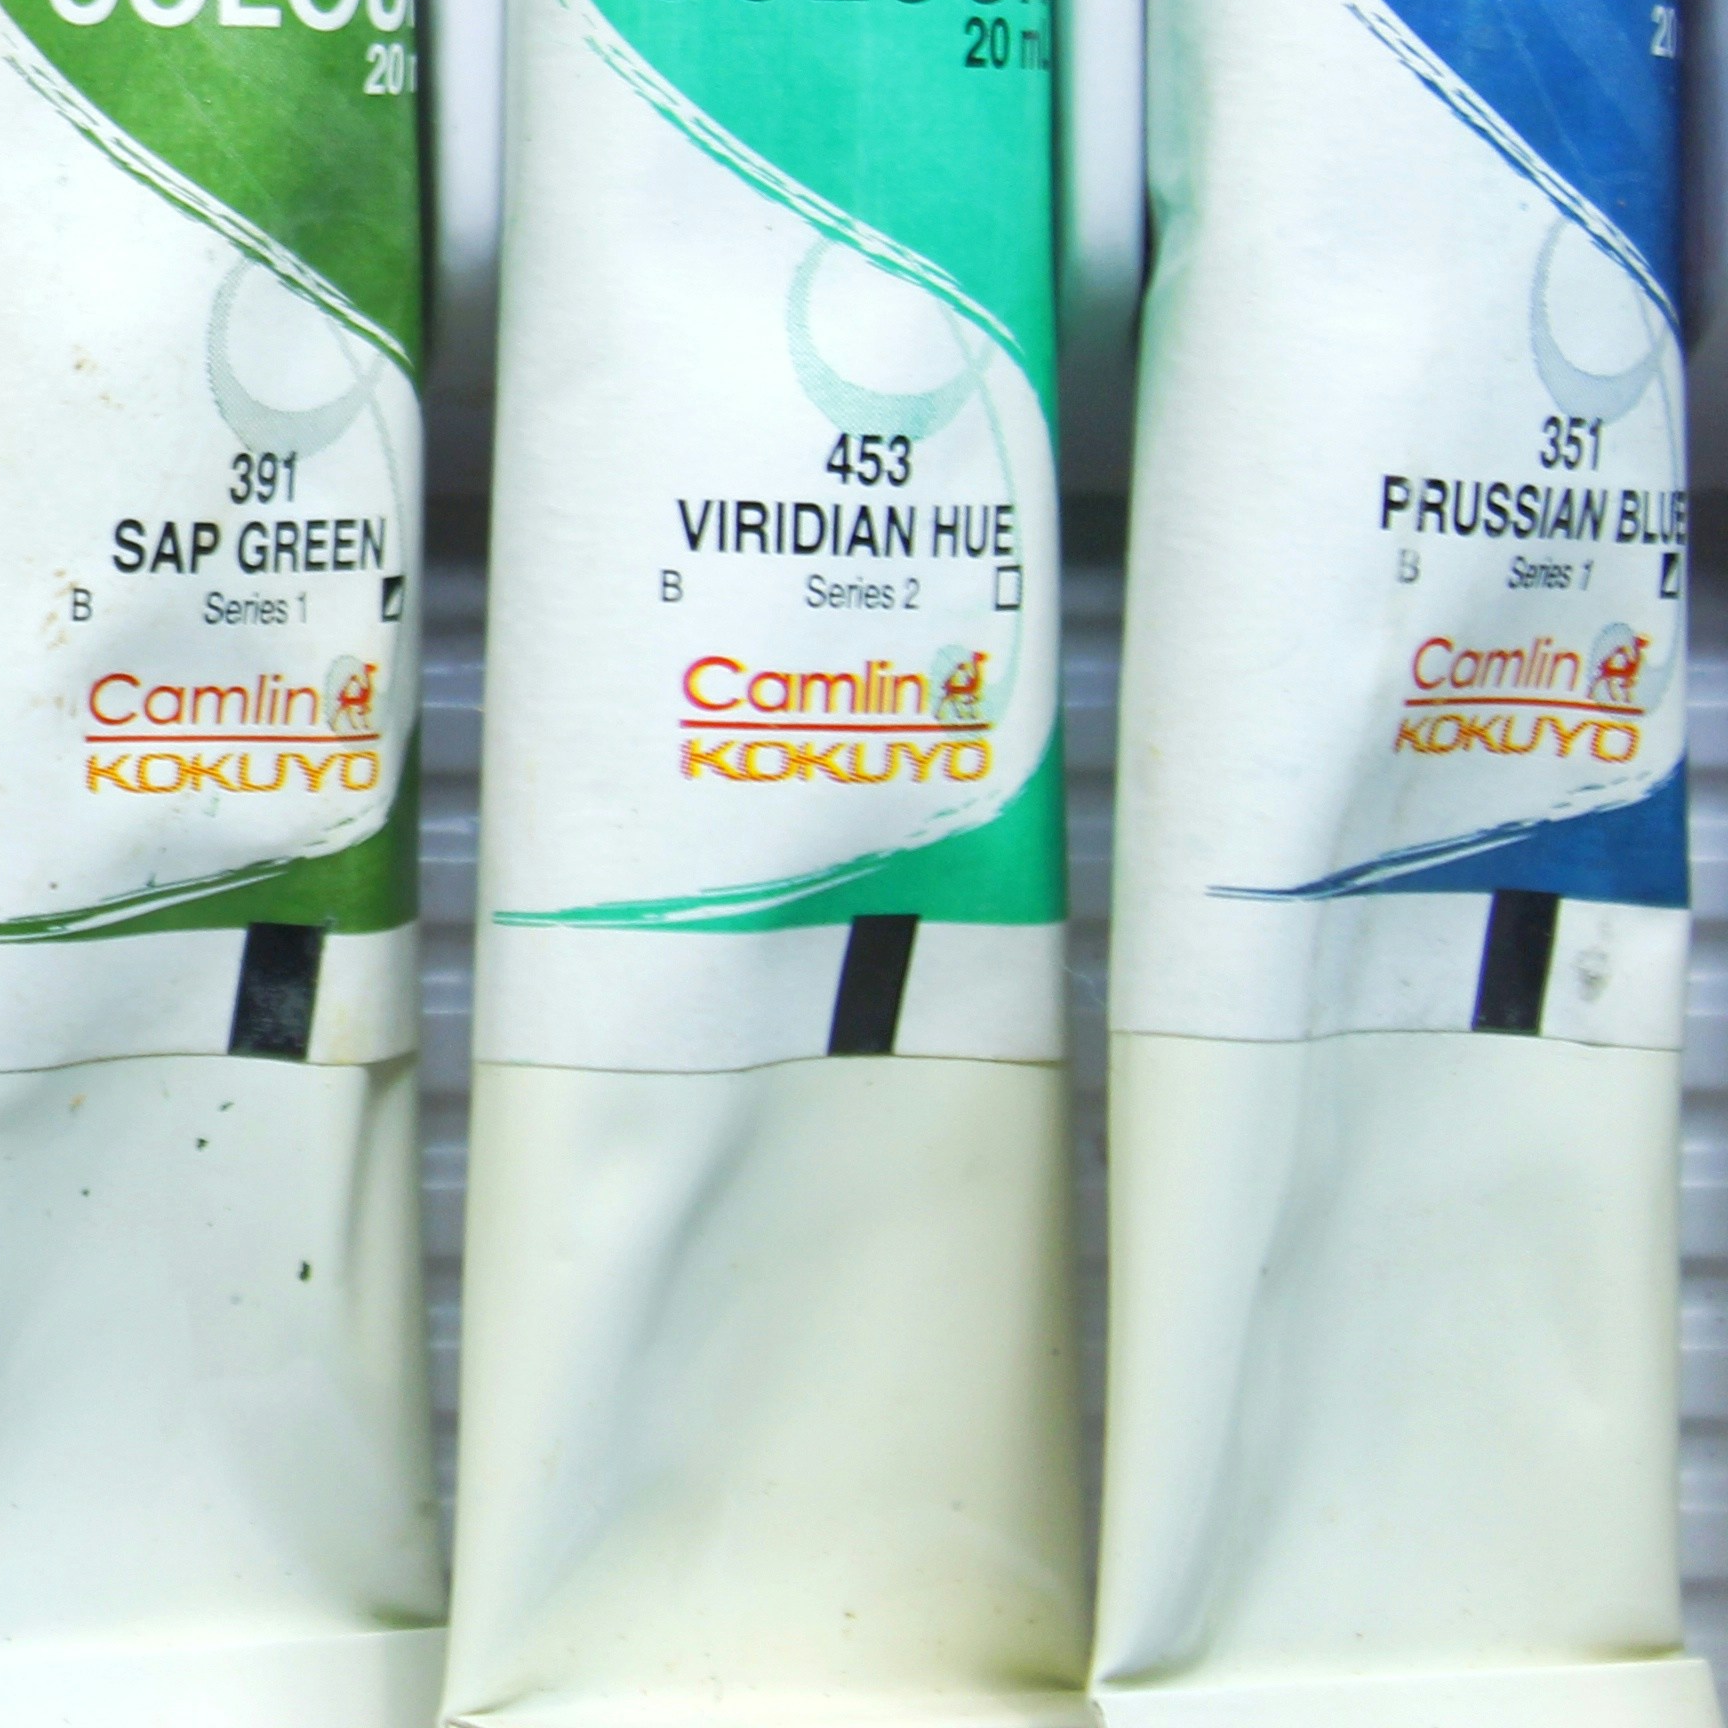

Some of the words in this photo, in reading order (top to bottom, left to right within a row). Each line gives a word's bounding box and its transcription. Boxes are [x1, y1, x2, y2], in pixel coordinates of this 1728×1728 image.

[364, 43, 405, 97] 20
[963, 17, 1012, 70] 20
[825, 431, 912, 488] 453
[1540, 416, 1604, 471] 351
[229, 451, 298, 505] 391
[678, 498, 917, 559] VIRIDIAN
[933, 504, 1015, 558] HUE
[1380, 474, 1608, 543] PRUSSIAN
[1616, 489, 1687, 546] BLUE
[113, 519, 222, 574] SAP
[237, 517, 386, 574] GREEN
[1396, 548, 1421, 585] B
[1507, 556, 1573, 591] Series
[1578, 560, 1594, 591] 1
[72, 588, 93, 622] B
[205, 591, 289, 626] Series
[297, 592, 309, 624] 1
[660, 569, 685, 604] B
[805, 574, 896, 610] Series
[902, 578, 921, 610] 2
[683, 654, 928, 715] Camlin
[1412, 636, 1581, 692] Camlin
[89, 672, 320, 727] Camlin
[679, 739, 992, 784] KOKUYO
[1394, 714, 1640, 764] KOKUYO
[86, 751, 381, 795] KOKUYO
